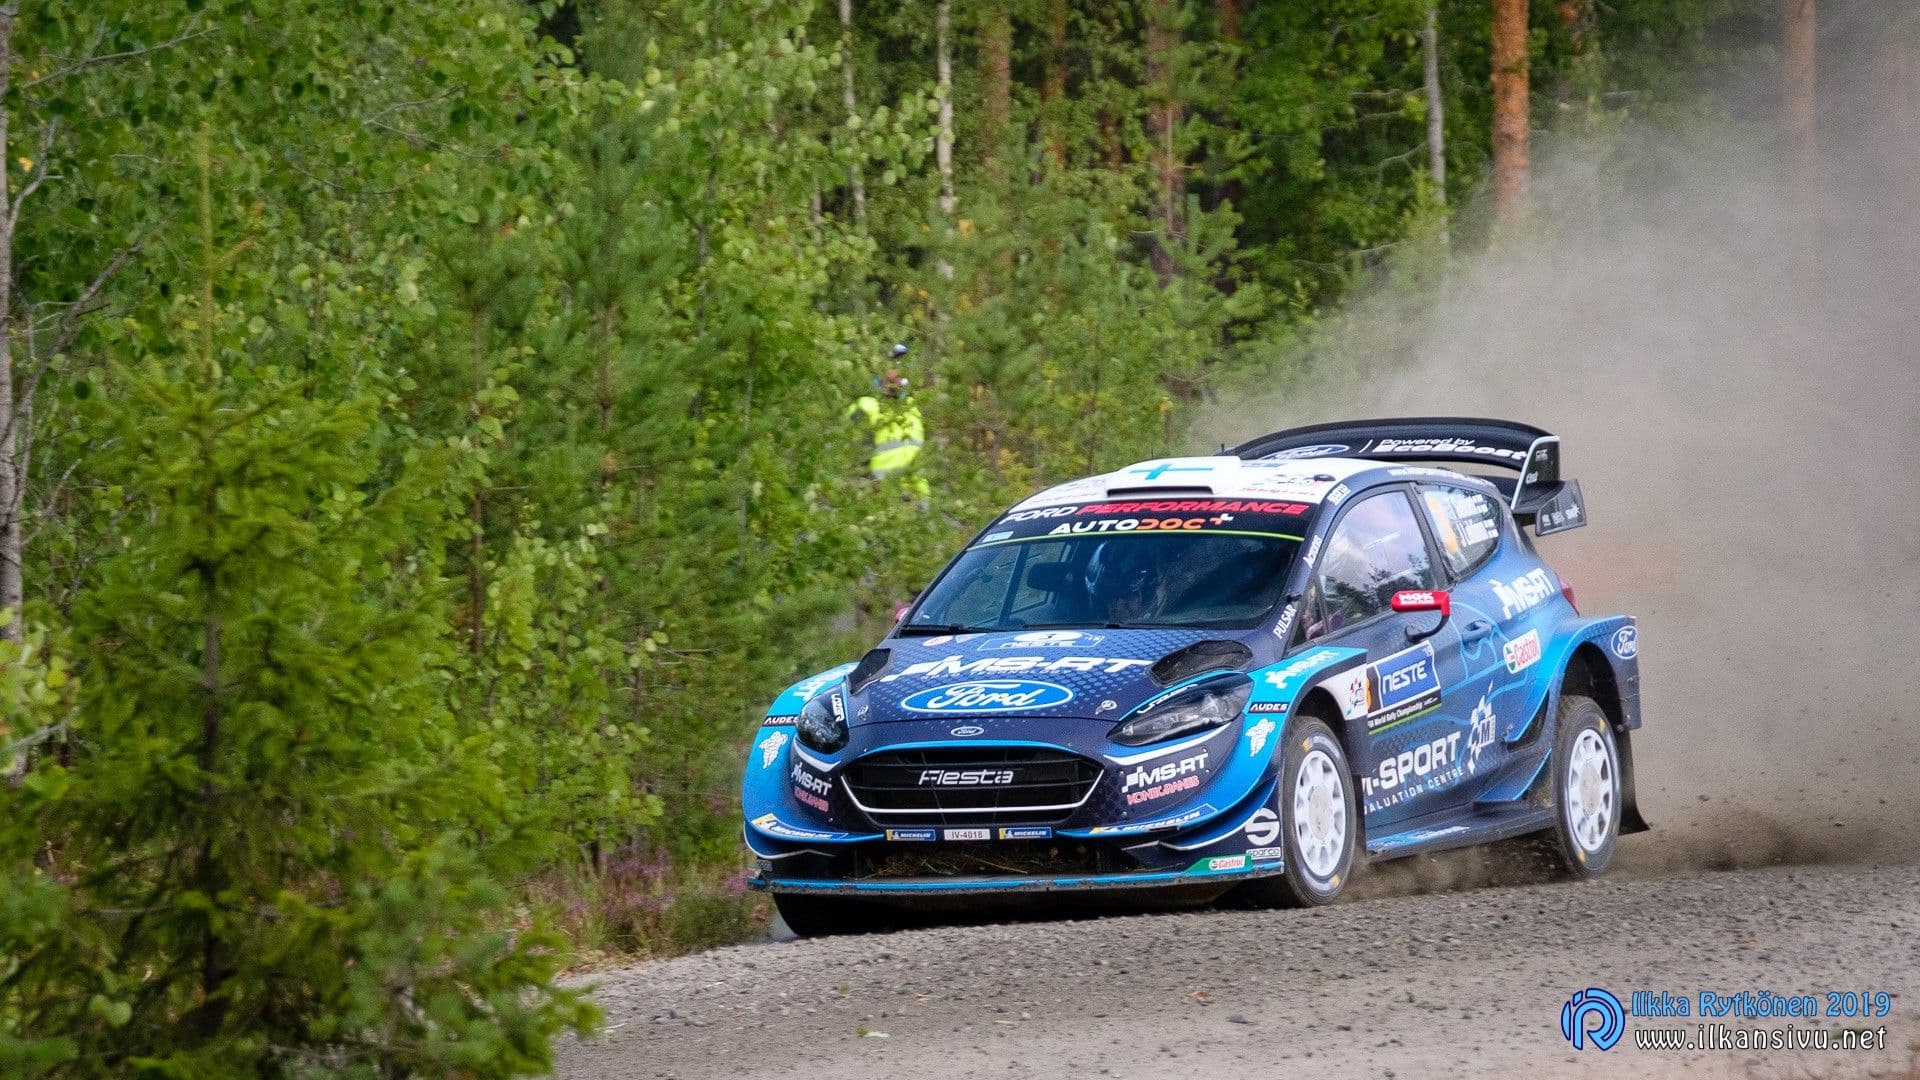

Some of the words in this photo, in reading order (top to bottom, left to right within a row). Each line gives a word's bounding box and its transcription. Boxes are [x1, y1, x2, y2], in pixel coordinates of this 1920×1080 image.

[1372, 444, 1528, 461] EcoBoost
[1379, 438, 1459, 446] Powered
[1460, 438, 1474, 446] by
[999, 506, 1078, 525] FORD
[1075, 501, 1310, 516] PERFORMANCE
[1273, 603, 1298, 640] PULSAR
[1382, 660, 1428, 694] NESTE
[927, 682, 1046, 709] Ford
[1250, 703, 1288, 712] AUDES
[918, 769, 1014, 785] Fiesta
[1138, 753, 1209, 788] MS-RT
[1427, 766, 1464, 789] CENTRE
[1217, 858, 1243, 869] Castrol
